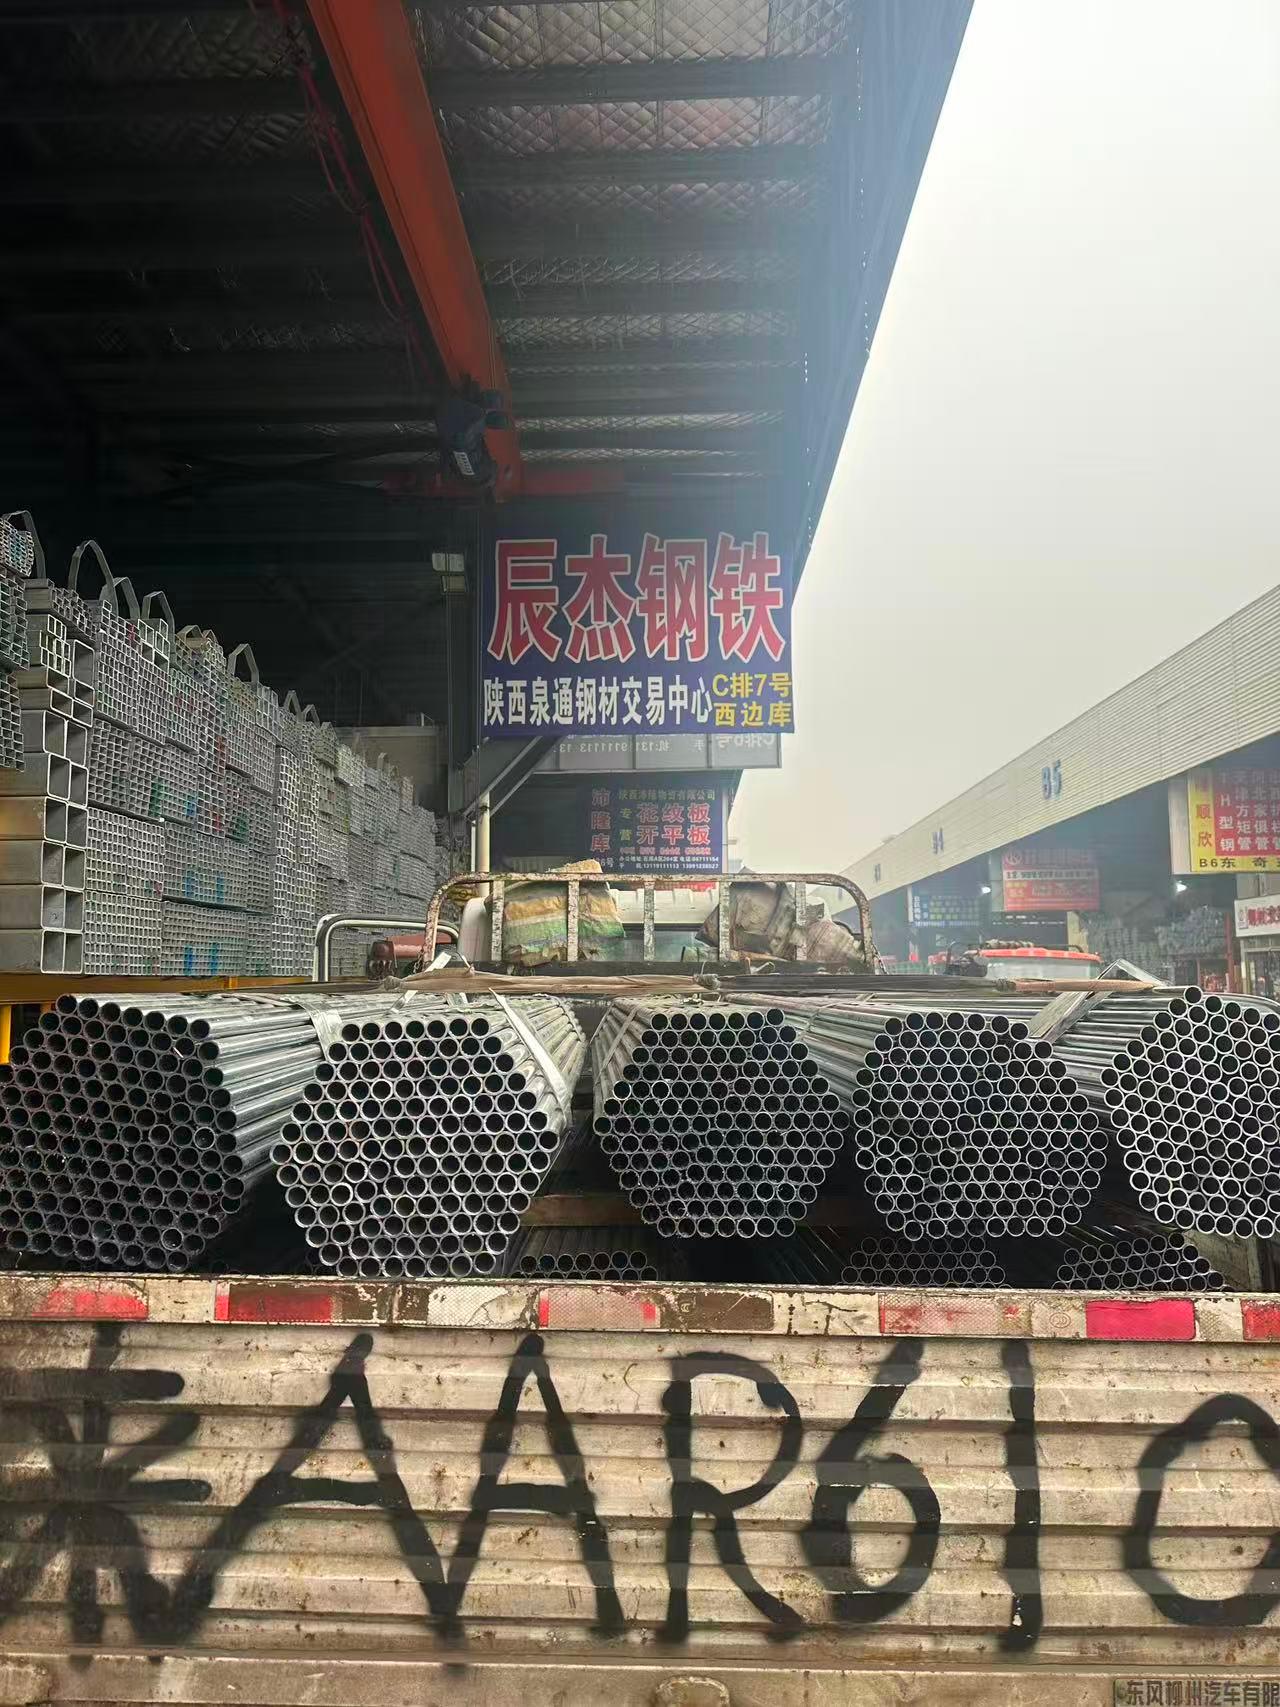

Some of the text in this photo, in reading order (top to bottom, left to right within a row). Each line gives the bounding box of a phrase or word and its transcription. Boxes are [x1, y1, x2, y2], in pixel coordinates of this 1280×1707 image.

[487, 532, 786, 664] 辰杰钢铁
[712, 672, 792, 699] C排7号
[483, 674, 713, 727] 陕西泉通钢材交易中心
[713, 701, 792, 728] 西边库
[637, 802, 711, 824] 花纹板
[637, 825, 711, 846] 开平板
